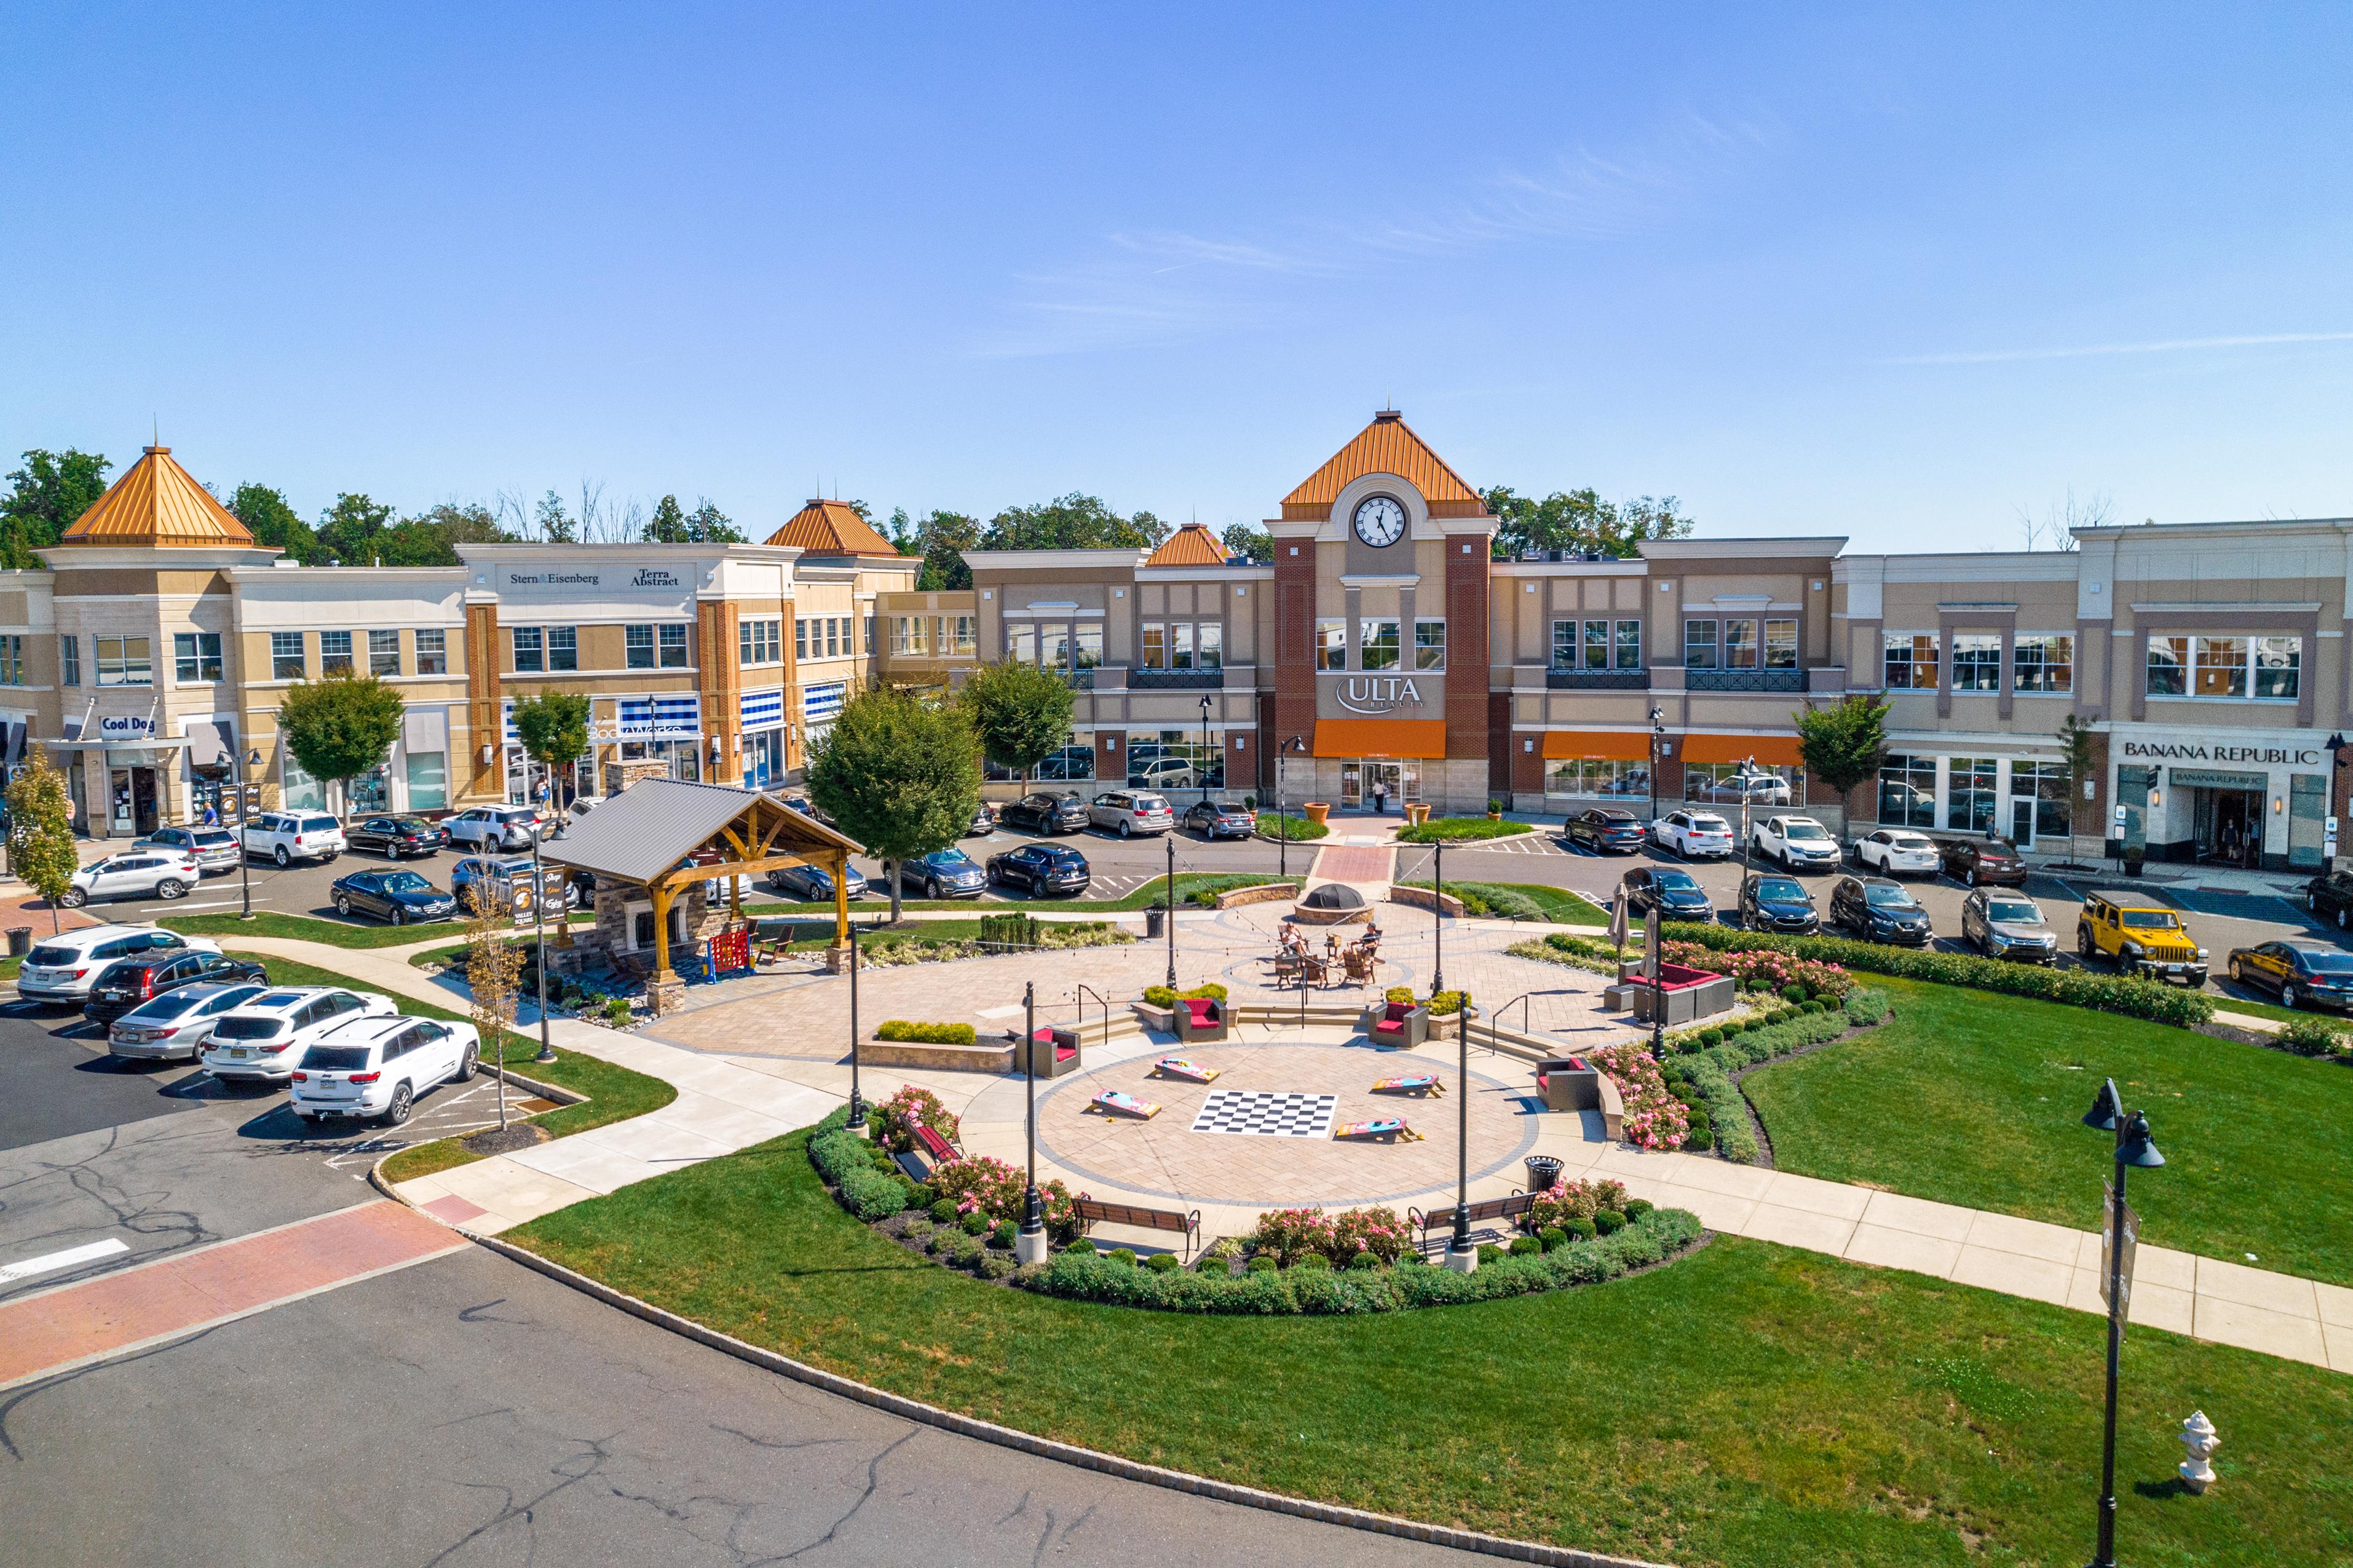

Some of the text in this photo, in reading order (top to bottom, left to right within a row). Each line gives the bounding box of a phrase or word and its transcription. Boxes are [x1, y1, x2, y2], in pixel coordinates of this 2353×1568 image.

[639, 569, 669, 578] Terra
[630, 576, 679, 586] Abstract
[1349, 678, 1421, 701] ULTA
[102, 718, 155, 732] Cool Dog
[2125, 742, 2319, 765] BANANA REPUBLIC
[2177, 773, 2215, 782] BANANA
[545, 873, 561, 882] Shop
[545, 898, 563, 909] Enjoy
